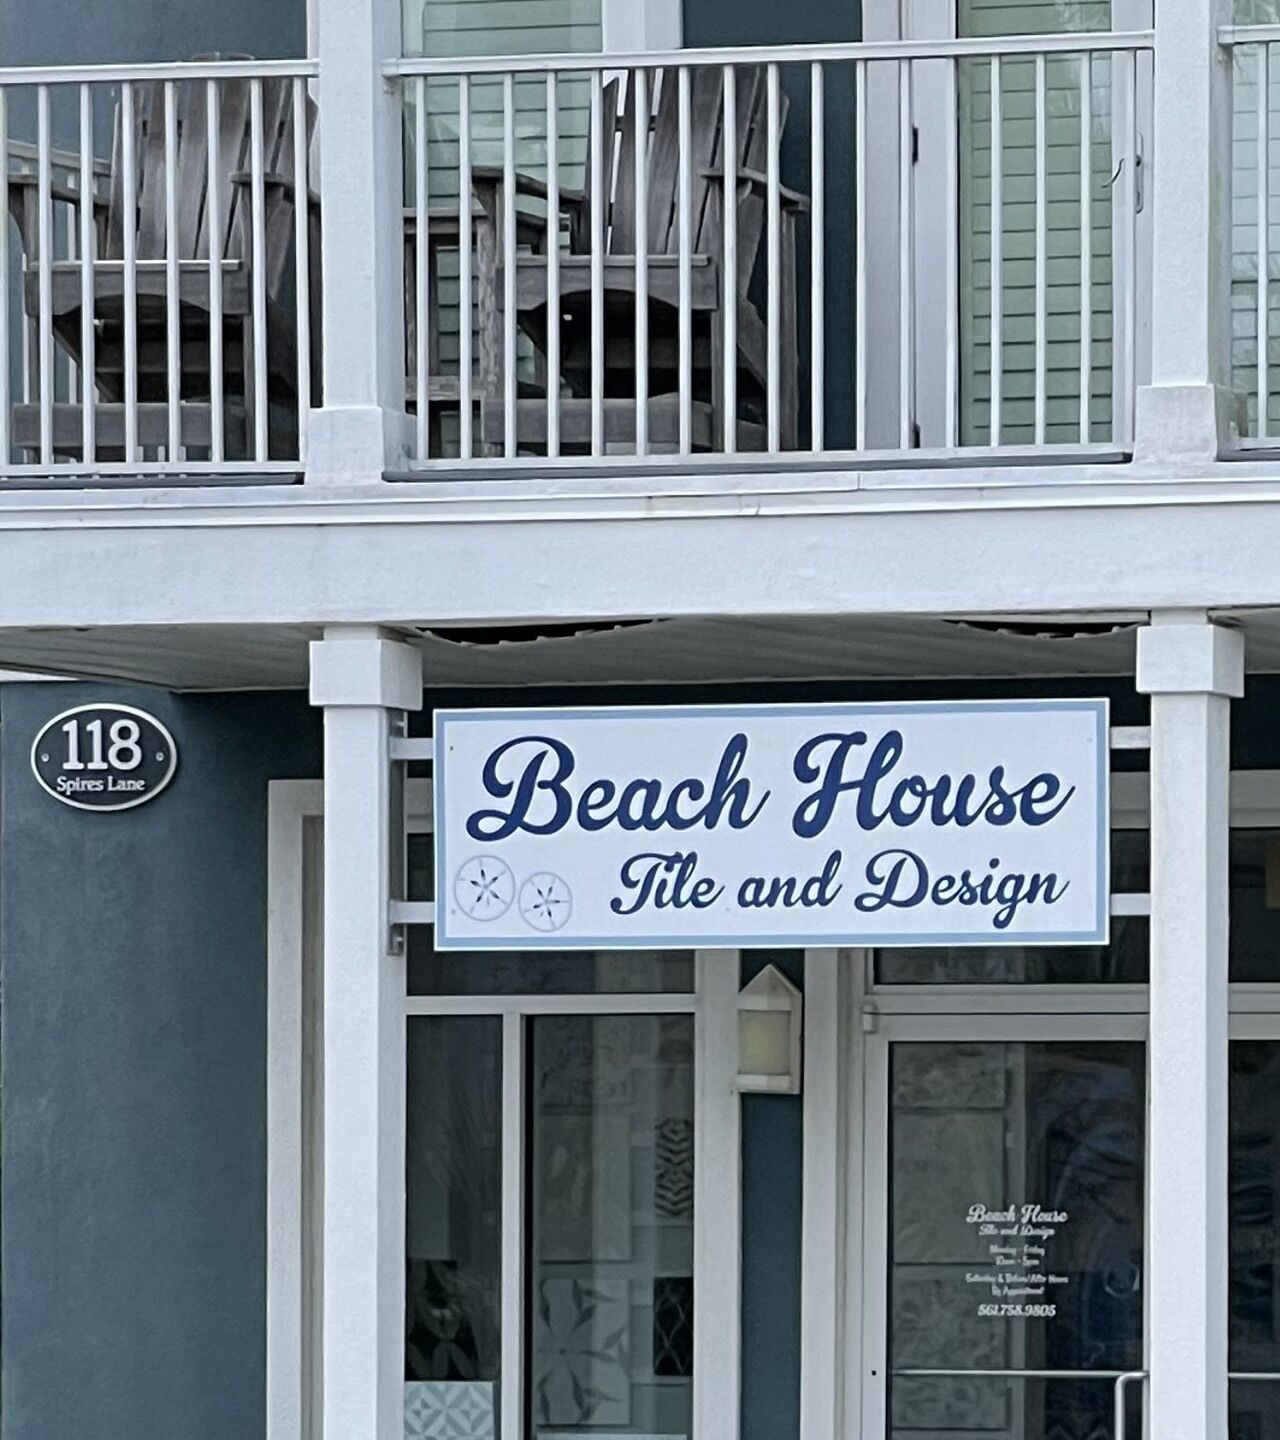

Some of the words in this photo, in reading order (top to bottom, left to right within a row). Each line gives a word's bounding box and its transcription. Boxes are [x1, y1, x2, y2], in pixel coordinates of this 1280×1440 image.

[62, 718, 142, 770] 118
[56, 775, 104, 796] Spires
[107, 775, 146, 792] Lane
[465, 733, 770, 842] Beach
[792, 730, 1076, 839] House
[610, 851, 725, 915] Tile
[737, 849, 842, 908] and
[853, 848, 1070, 930] Design
[965, 1203, 1016, 1224] Beach
[1021, 1203, 1069, 1224] House
[977, 1303, 1056, 1317] 561.758.9805
